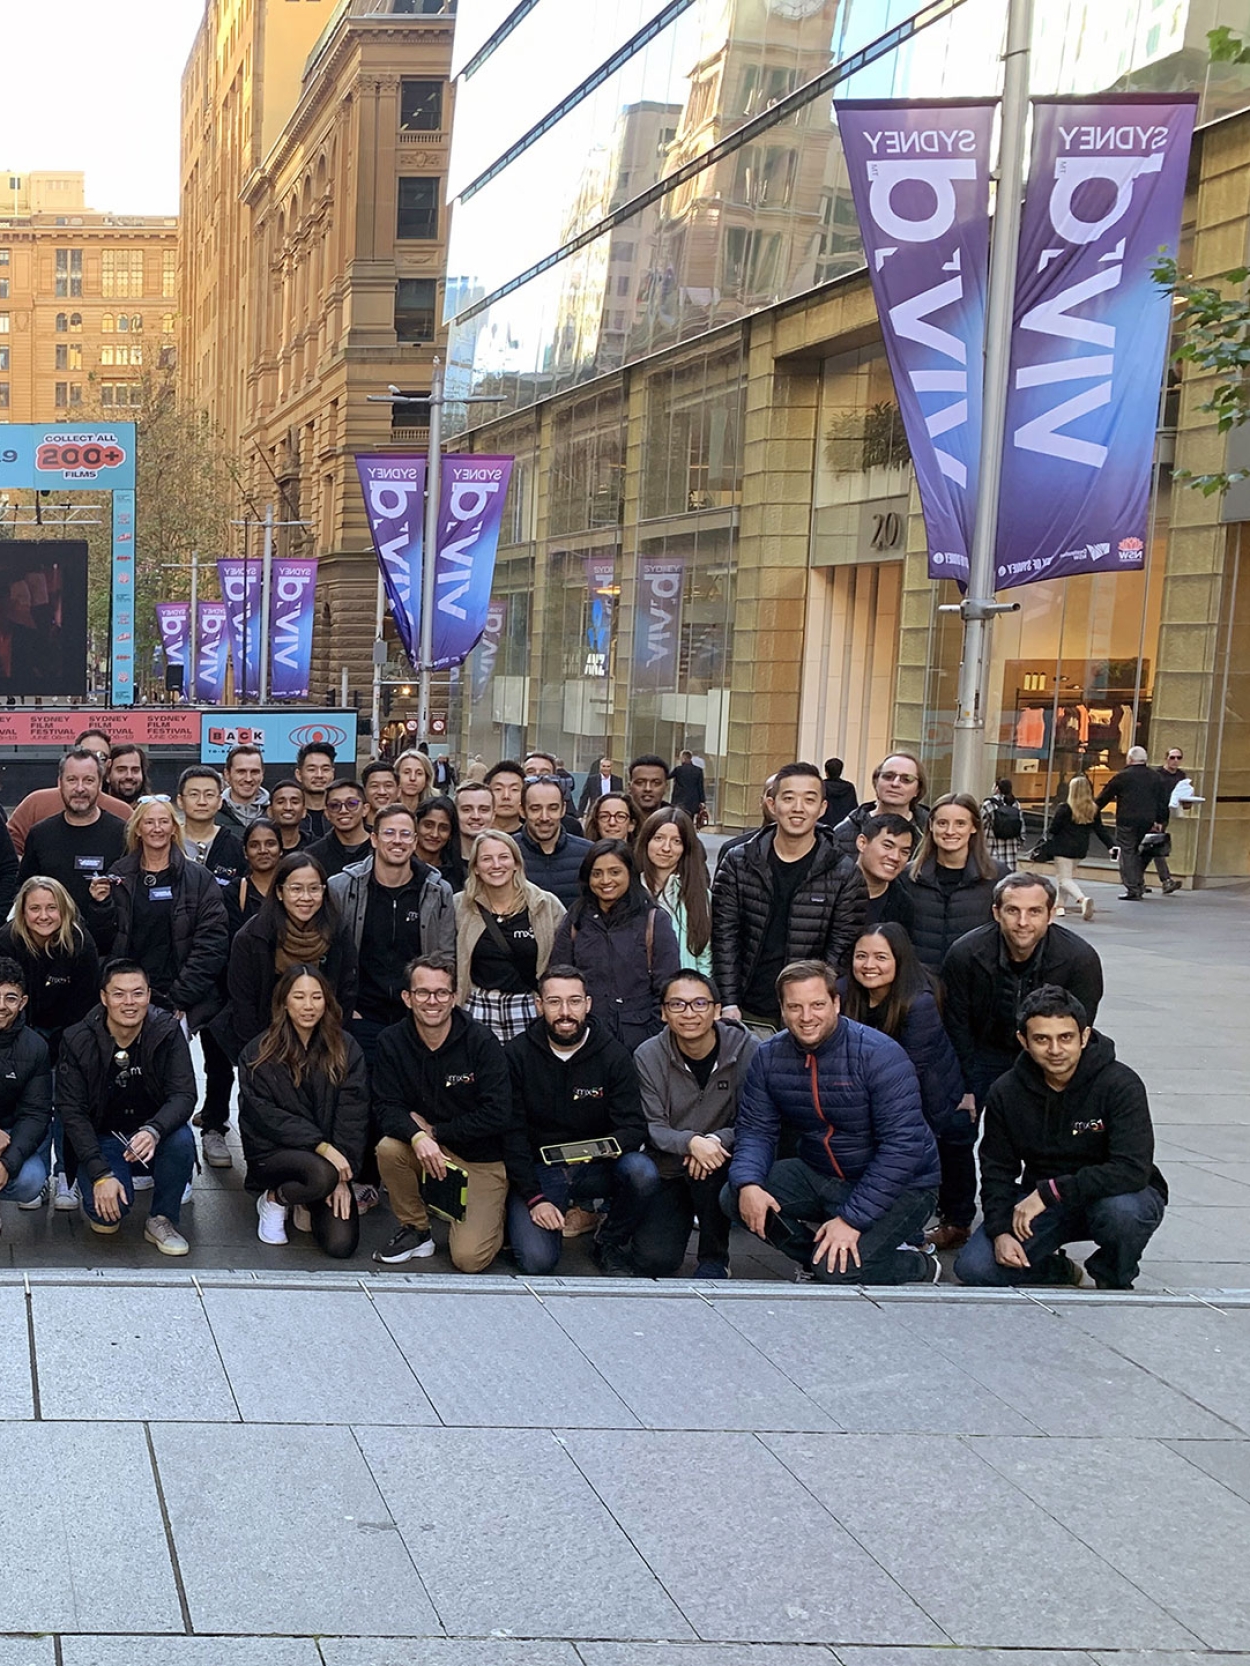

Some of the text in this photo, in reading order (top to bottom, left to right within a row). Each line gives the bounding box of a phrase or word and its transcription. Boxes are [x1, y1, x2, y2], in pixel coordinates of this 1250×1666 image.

[45, 434, 117, 443] COLLECT ALL
[41, 447, 121, 466] 200+
[212, 731, 263, 740] BACK
[1074, 1118, 1103, 1132] mx51
